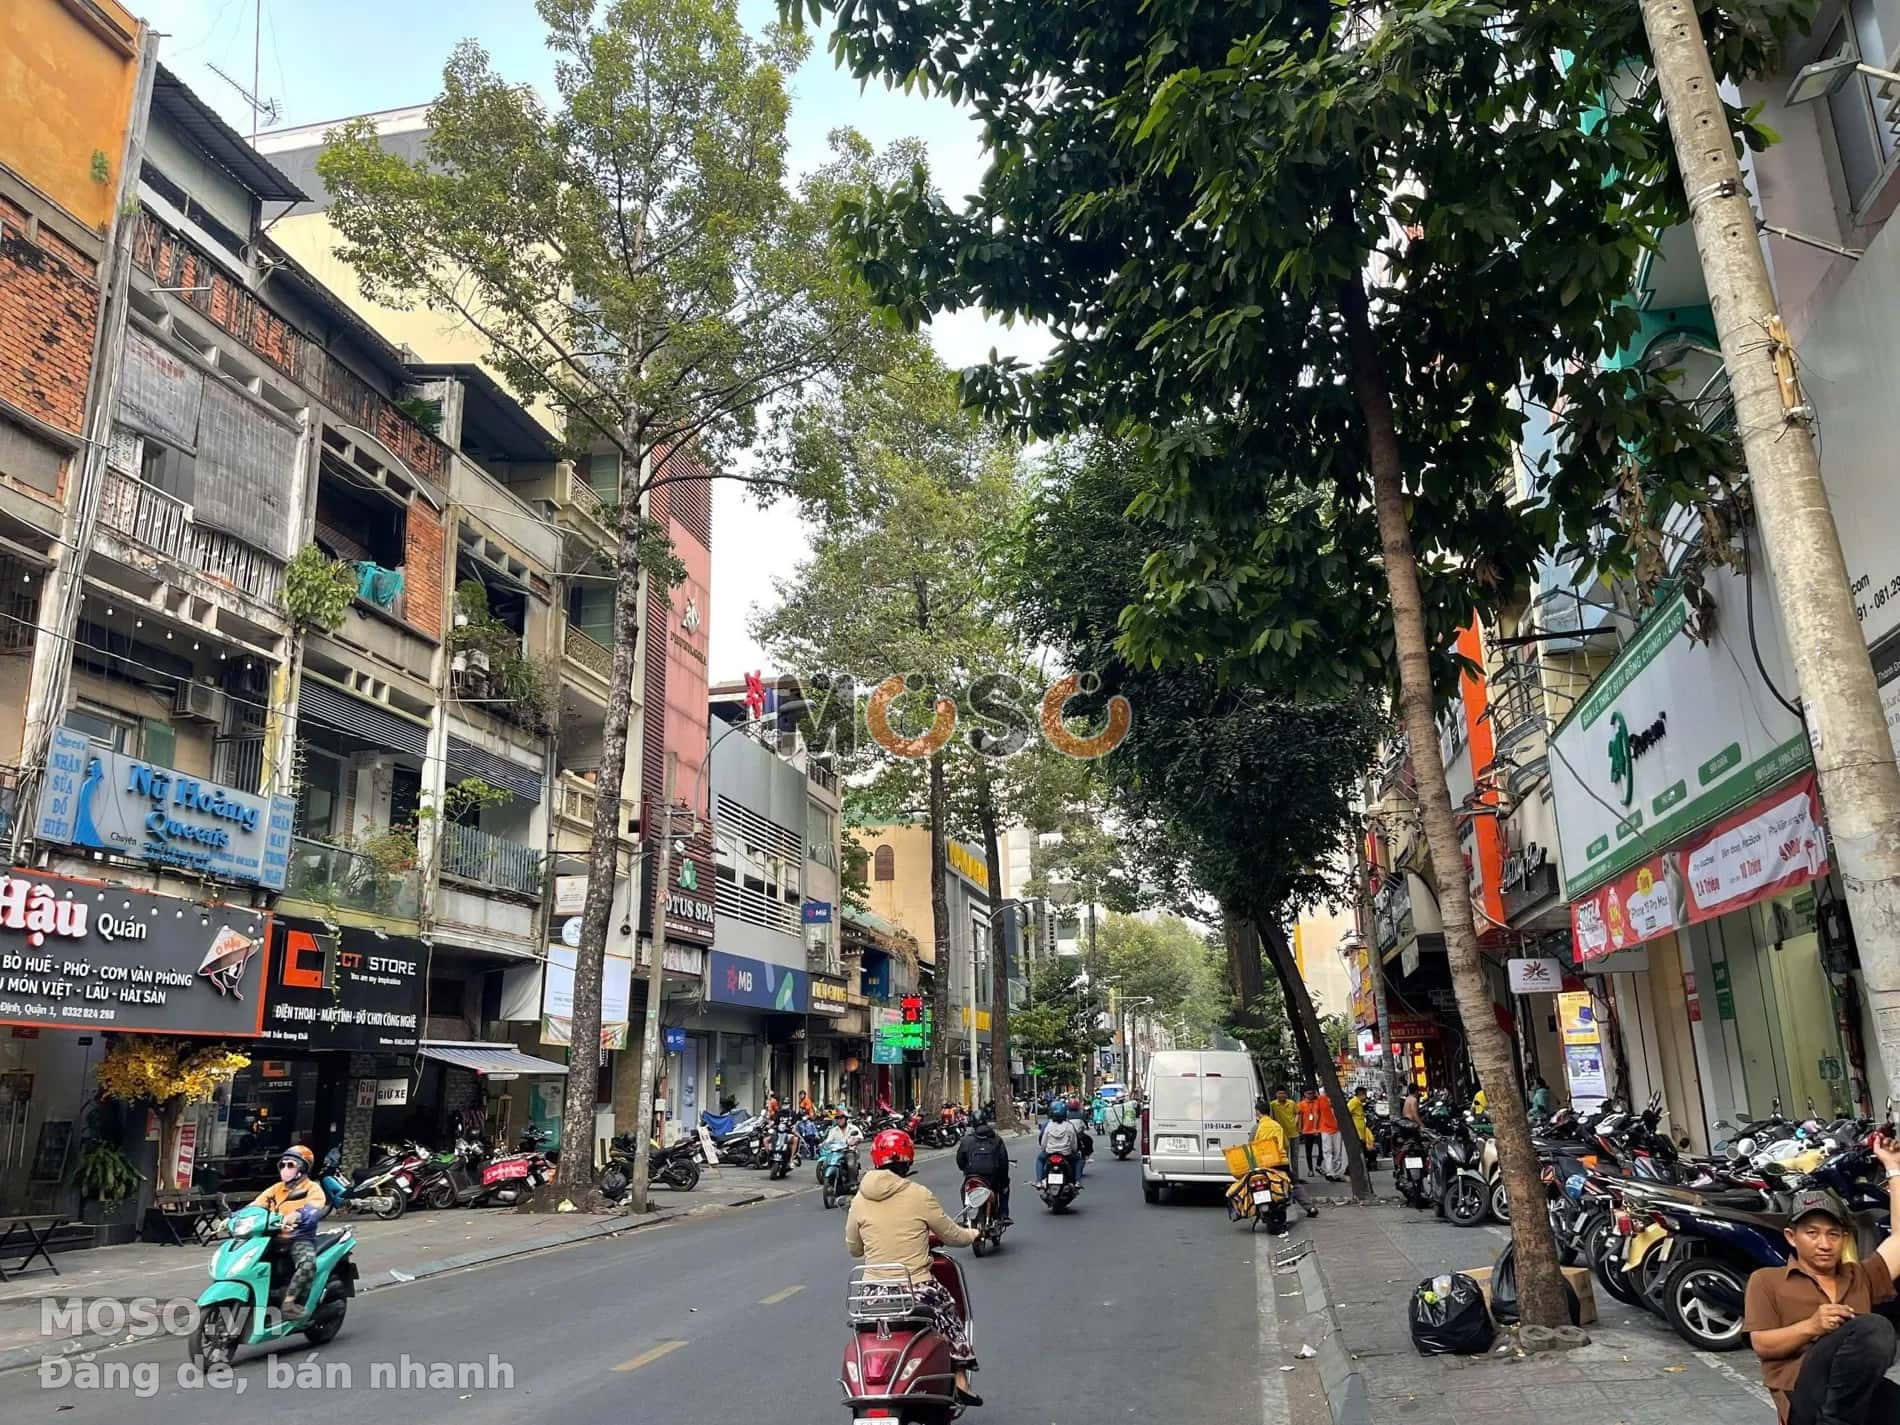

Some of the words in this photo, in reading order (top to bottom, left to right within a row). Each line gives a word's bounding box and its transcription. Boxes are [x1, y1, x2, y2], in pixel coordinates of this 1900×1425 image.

[666, 893, 694, 918] OTUS
[695, 901, 714, 923] SPA
[97, 912, 147, 942] Quán
[2, 950, 21, 970] BÒ
[63, 958, 91, 977] PHỞ
[100, 966, 128, 981] CƠM
[131, 965, 153, 983] VĂN
[155, 968, 193, 987] PHÒNG
[368, 956, 417, 976] STORE
[7, 974, 38, 994] MÓN
[41, 978, 73, 1000] VIỆT
[738, 970, 753, 992] MB
[275, 1002, 293, 1022] ĐIỆN
[294, 1006, 316, 1024] THOẠI
[394, 1088, 406, 1099] XE
